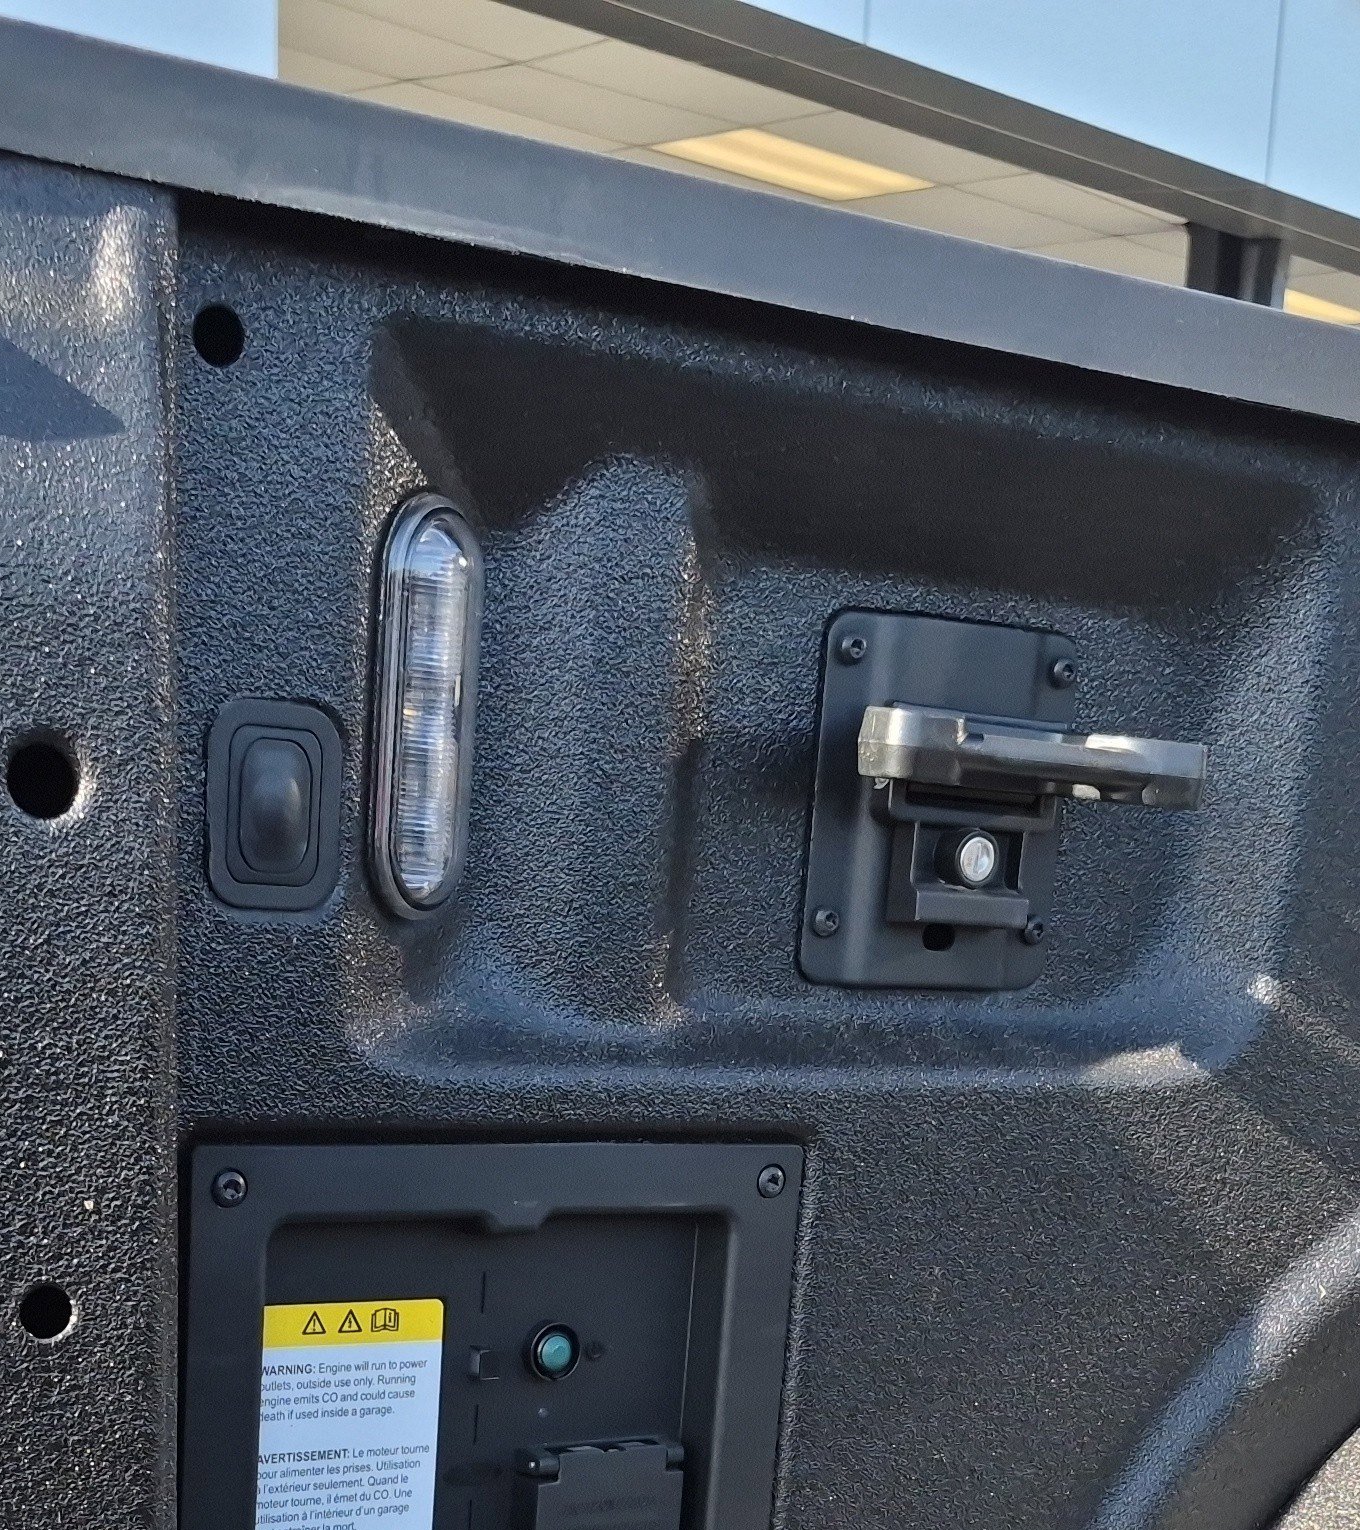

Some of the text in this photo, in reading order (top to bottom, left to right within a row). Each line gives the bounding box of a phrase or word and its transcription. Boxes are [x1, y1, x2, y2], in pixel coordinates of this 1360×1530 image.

[318, 1362, 352, 1376] Engine
[354, 1360, 370, 1372] will
[371, 1362, 386, 1371] run
[388, 1360, 398, 1370] to
[400, 1360, 428, 1372] power
[296, 1378, 332, 1390] outside
[334, 1378, 352, 1388] use
[354, 1376, 374, 1388] only.
[377, 1374, 416, 1386] Running
[294, 1394, 320, 1405] emits
[322, 1392, 338, 1404] CO
[340, 1390, 358, 1402] and
[360, 1388, 386, 1400] could
[388, 1389, 416, 1399] cause
[288, 1409, 294, 1420] if
[296, 1408, 318, 1420] used
[321, 1406, 350, 1418] inside
[351, 1408, 358, 1416] a
[359, 1406, 395, 1418] garage.
[258, 1448, 350, 1464] AVERTISSEMENT:
[352, 1448, 364, 1459] Le
[366, 1446, 399, 1458] moteur
[280, 1466, 325, 1478] alimenter
[327, 1464, 340, 1474] les
[342, 1462, 374, 1476] prises.
[376, 1459, 420, 1472] Utilisation
[264, 1482, 312, 1494] l'extérieur
[312, 1479, 364, 1490] seulement.
[368, 1475, 398, 1487] Quand
[400, 1474, 409, 1484] le
[326, 1494, 332, 1504] il
[334, 1492, 358, 1504] émet
[360, 1490, 372, 1502] du
[374, 1489, 392, 1500] CO.
[394, 1488, 413, 1499] Une
[302, 1512, 308, 1521] à
[356, 1505, 376, 1516] d'un
[378, 1504, 410, 1516] garage
